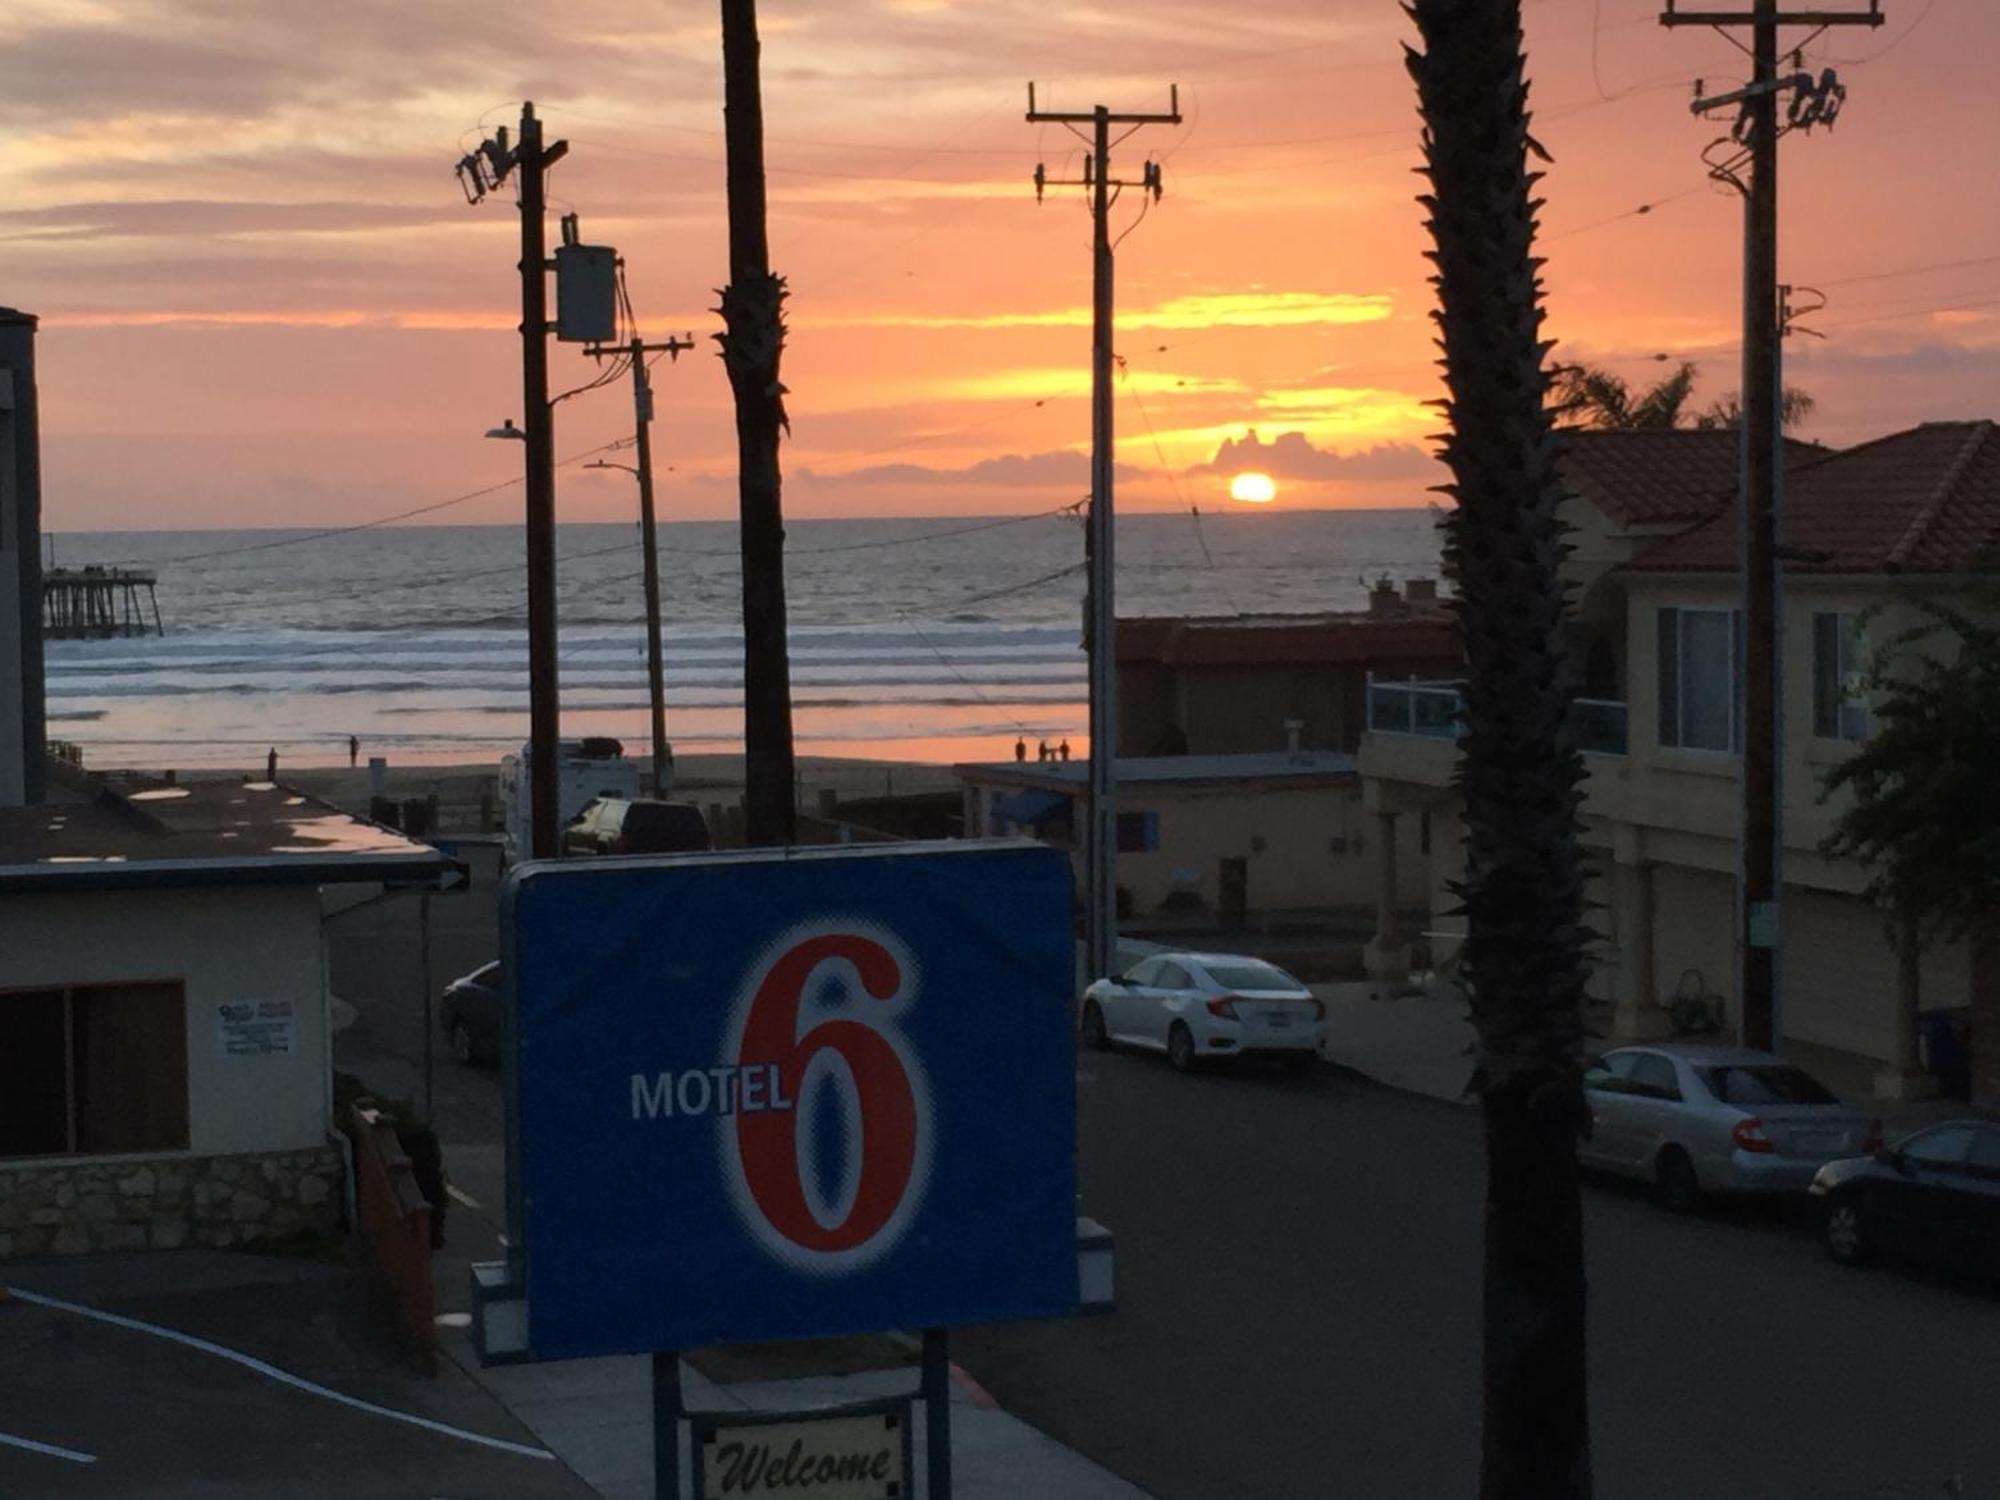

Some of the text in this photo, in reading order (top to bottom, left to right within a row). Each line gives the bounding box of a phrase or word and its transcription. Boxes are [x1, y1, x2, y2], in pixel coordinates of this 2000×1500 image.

[631, 930, 922, 1258] MOTEL 6
[715, 1438, 890, 1493] Welcome
